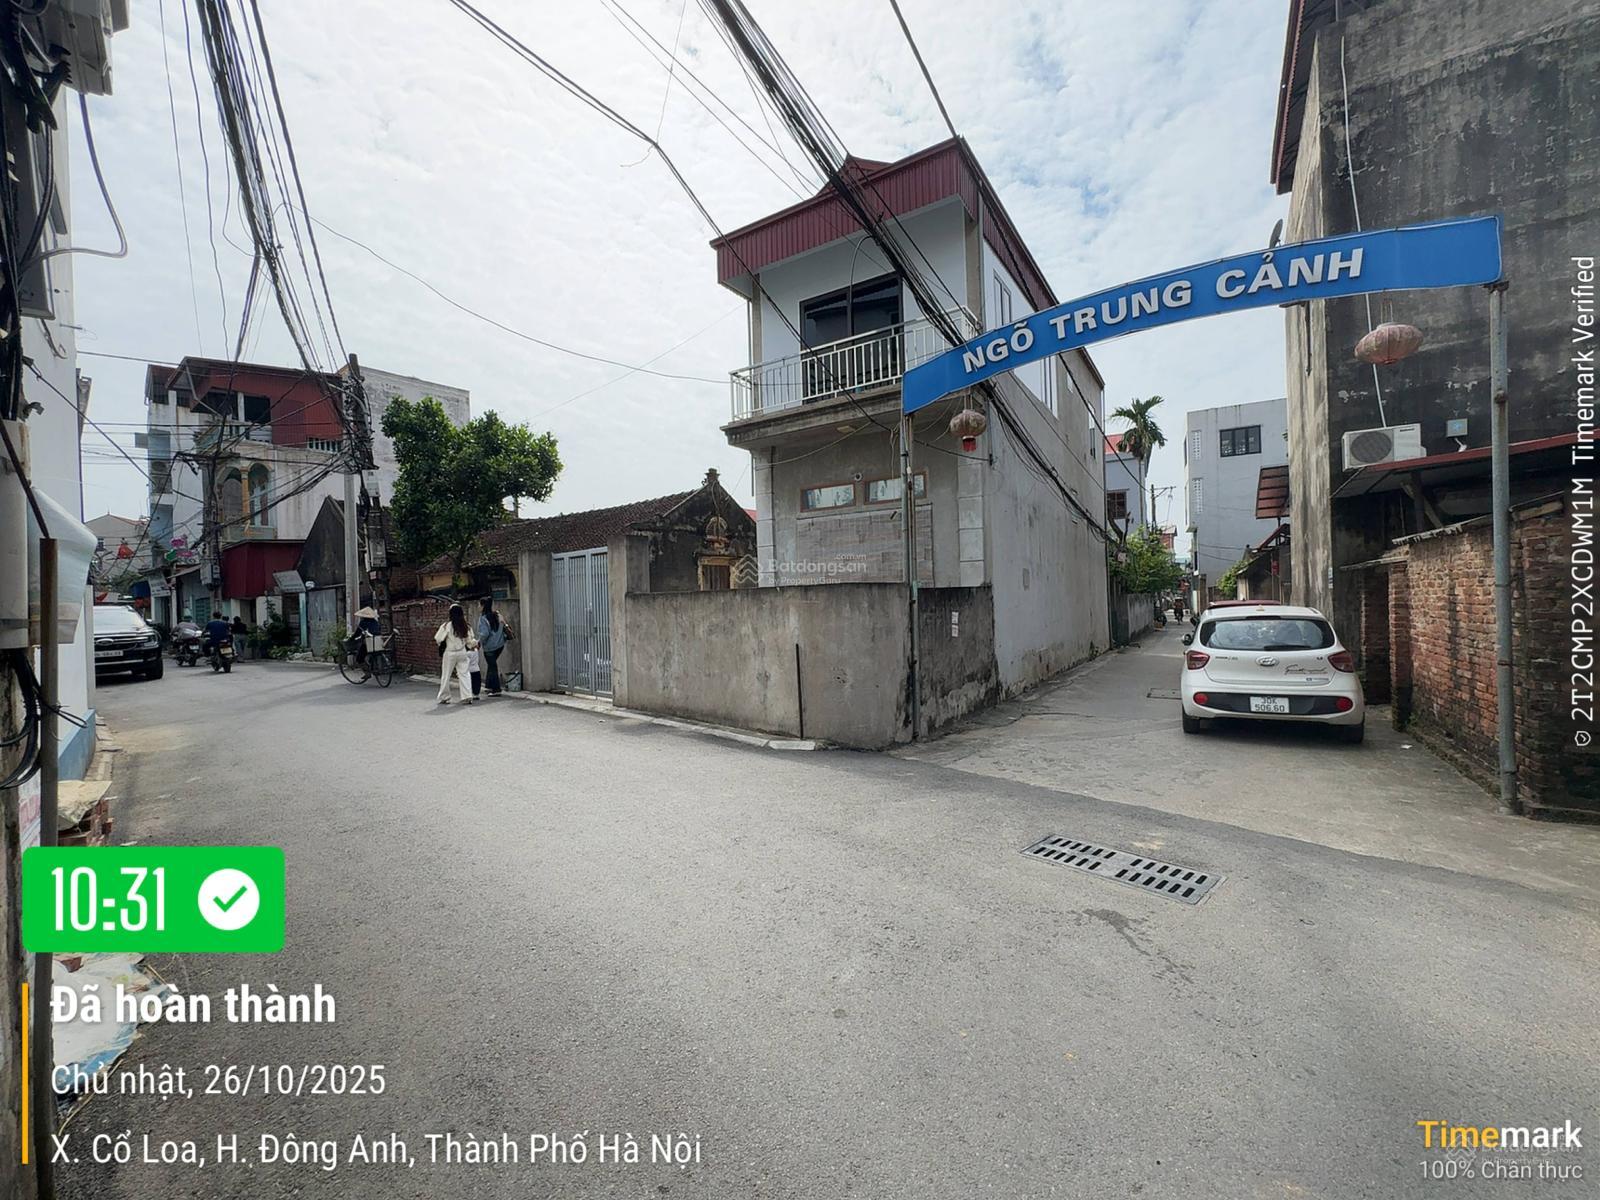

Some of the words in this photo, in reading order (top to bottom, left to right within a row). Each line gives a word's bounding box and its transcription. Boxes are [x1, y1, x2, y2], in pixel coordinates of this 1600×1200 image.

[962, 321, 1034, 373] NGÕ
[1049, 280, 1192, 340] TRUNG
[1215, 247, 1364, 299] CẢNH
